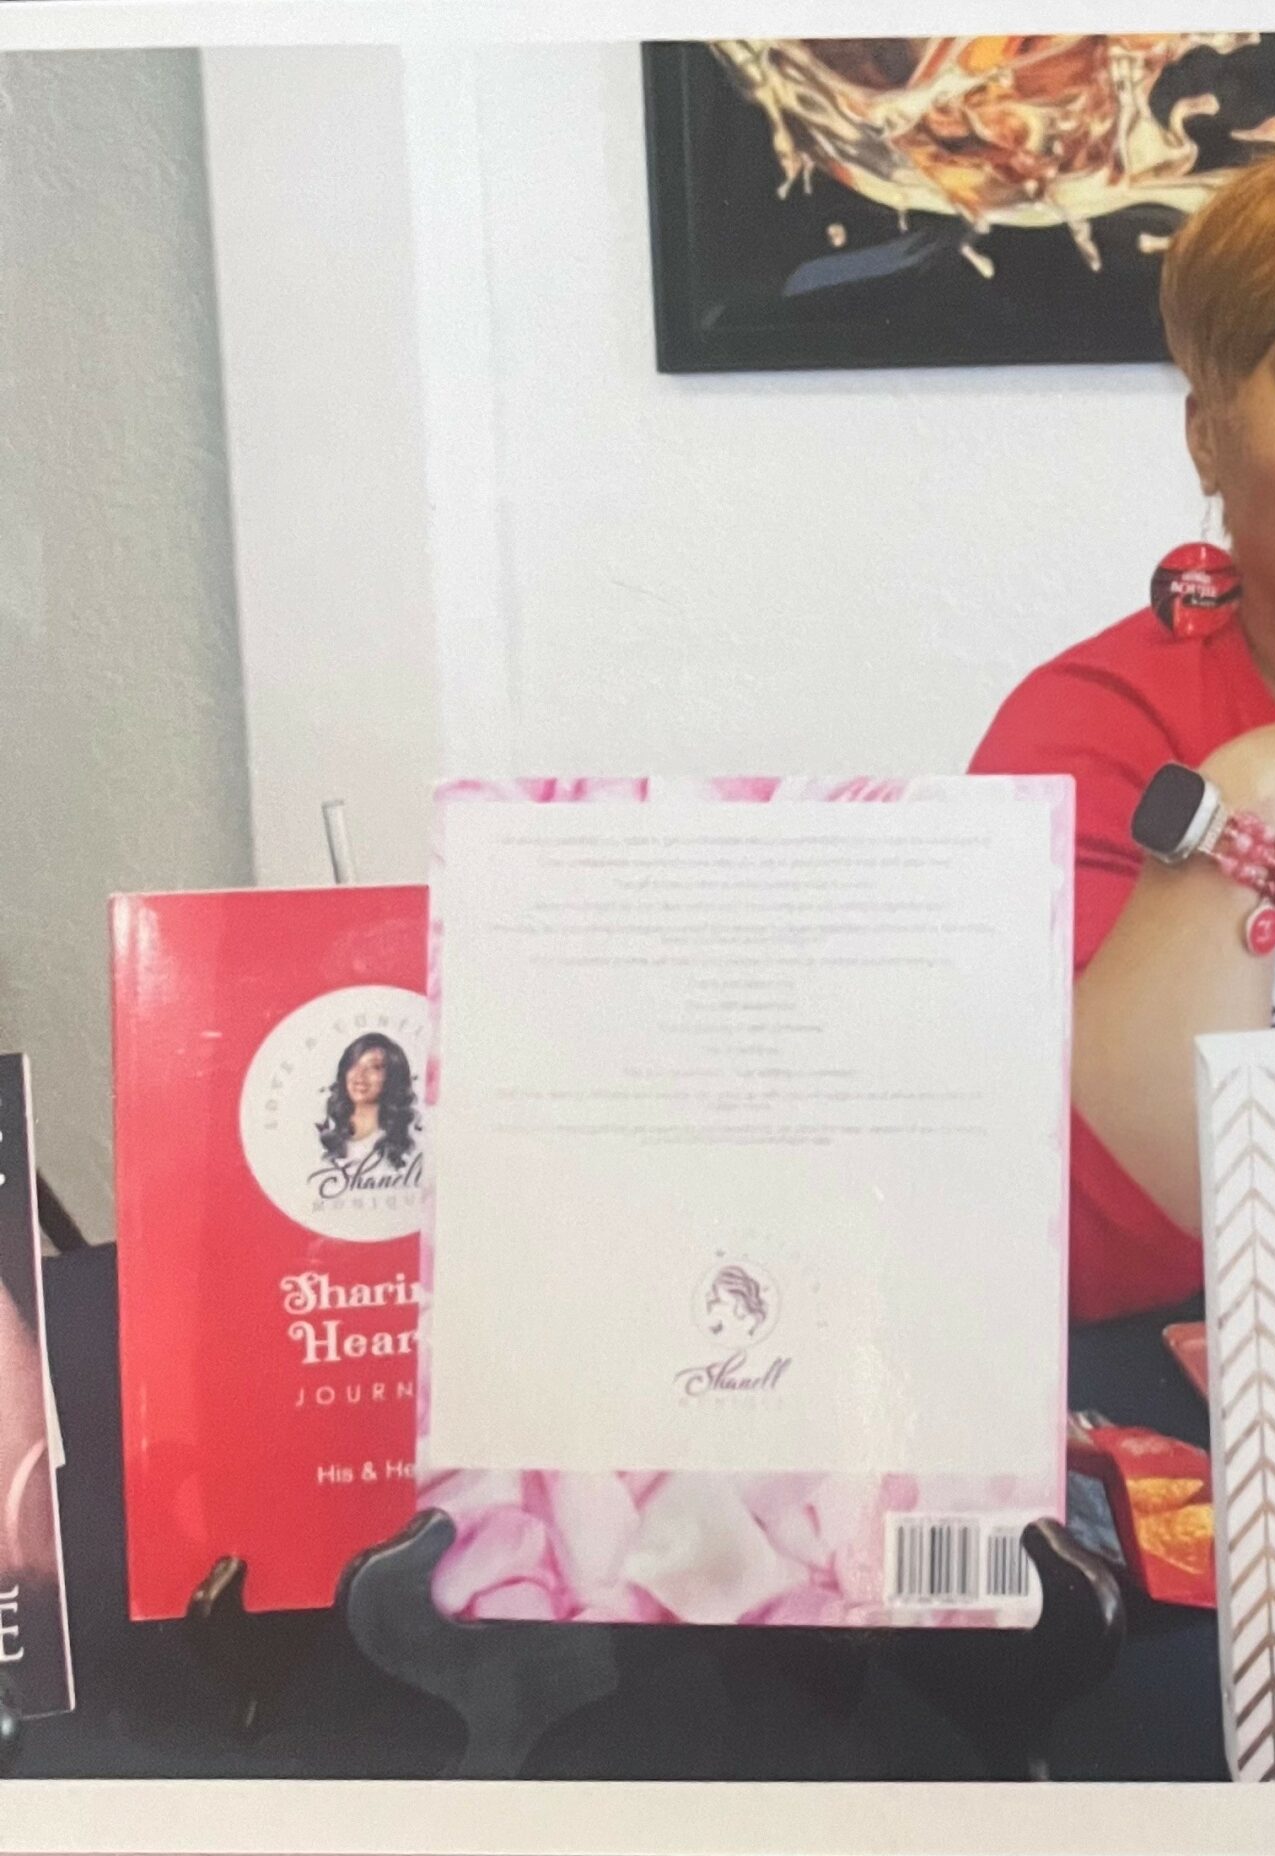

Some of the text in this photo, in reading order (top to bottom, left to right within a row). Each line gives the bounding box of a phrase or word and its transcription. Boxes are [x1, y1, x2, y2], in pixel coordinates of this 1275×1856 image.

[307, 1151, 424, 1199] Shanell
[296, 1380, 415, 1407] JOURN
[316, 1464, 354, 1484] His
[361, 1460, 378, 1480] &
